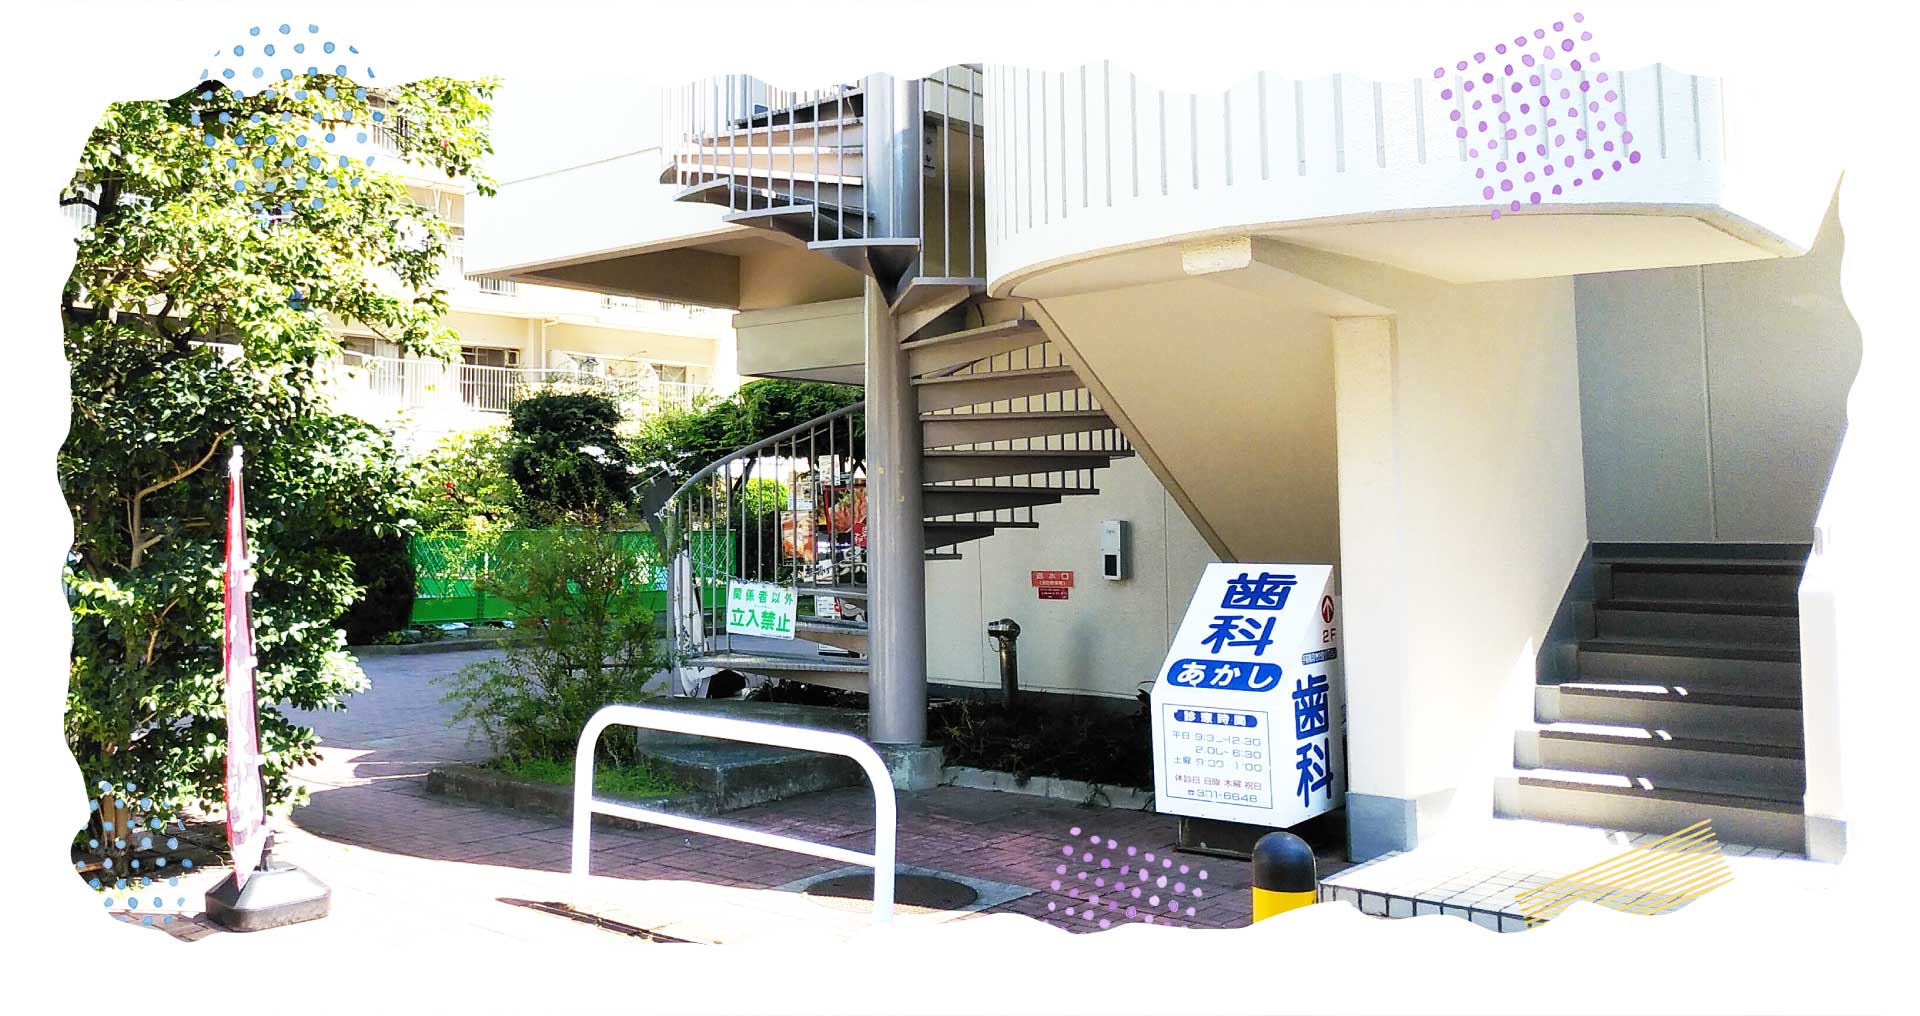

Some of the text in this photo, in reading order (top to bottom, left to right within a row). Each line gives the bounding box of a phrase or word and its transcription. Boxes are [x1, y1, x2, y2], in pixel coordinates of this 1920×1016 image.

[733, 587, 793, 606] 関係者以外
[730, 608, 791, 632] 立入禁止
[1201, 572, 1298, 656] 歯科
[1322, 627, 1337, 643] 2F
[1177, 661, 1274, 689] あかし
[1172, 730, 1190, 740] 平日
[1292, 673, 1334, 808] 歯科
